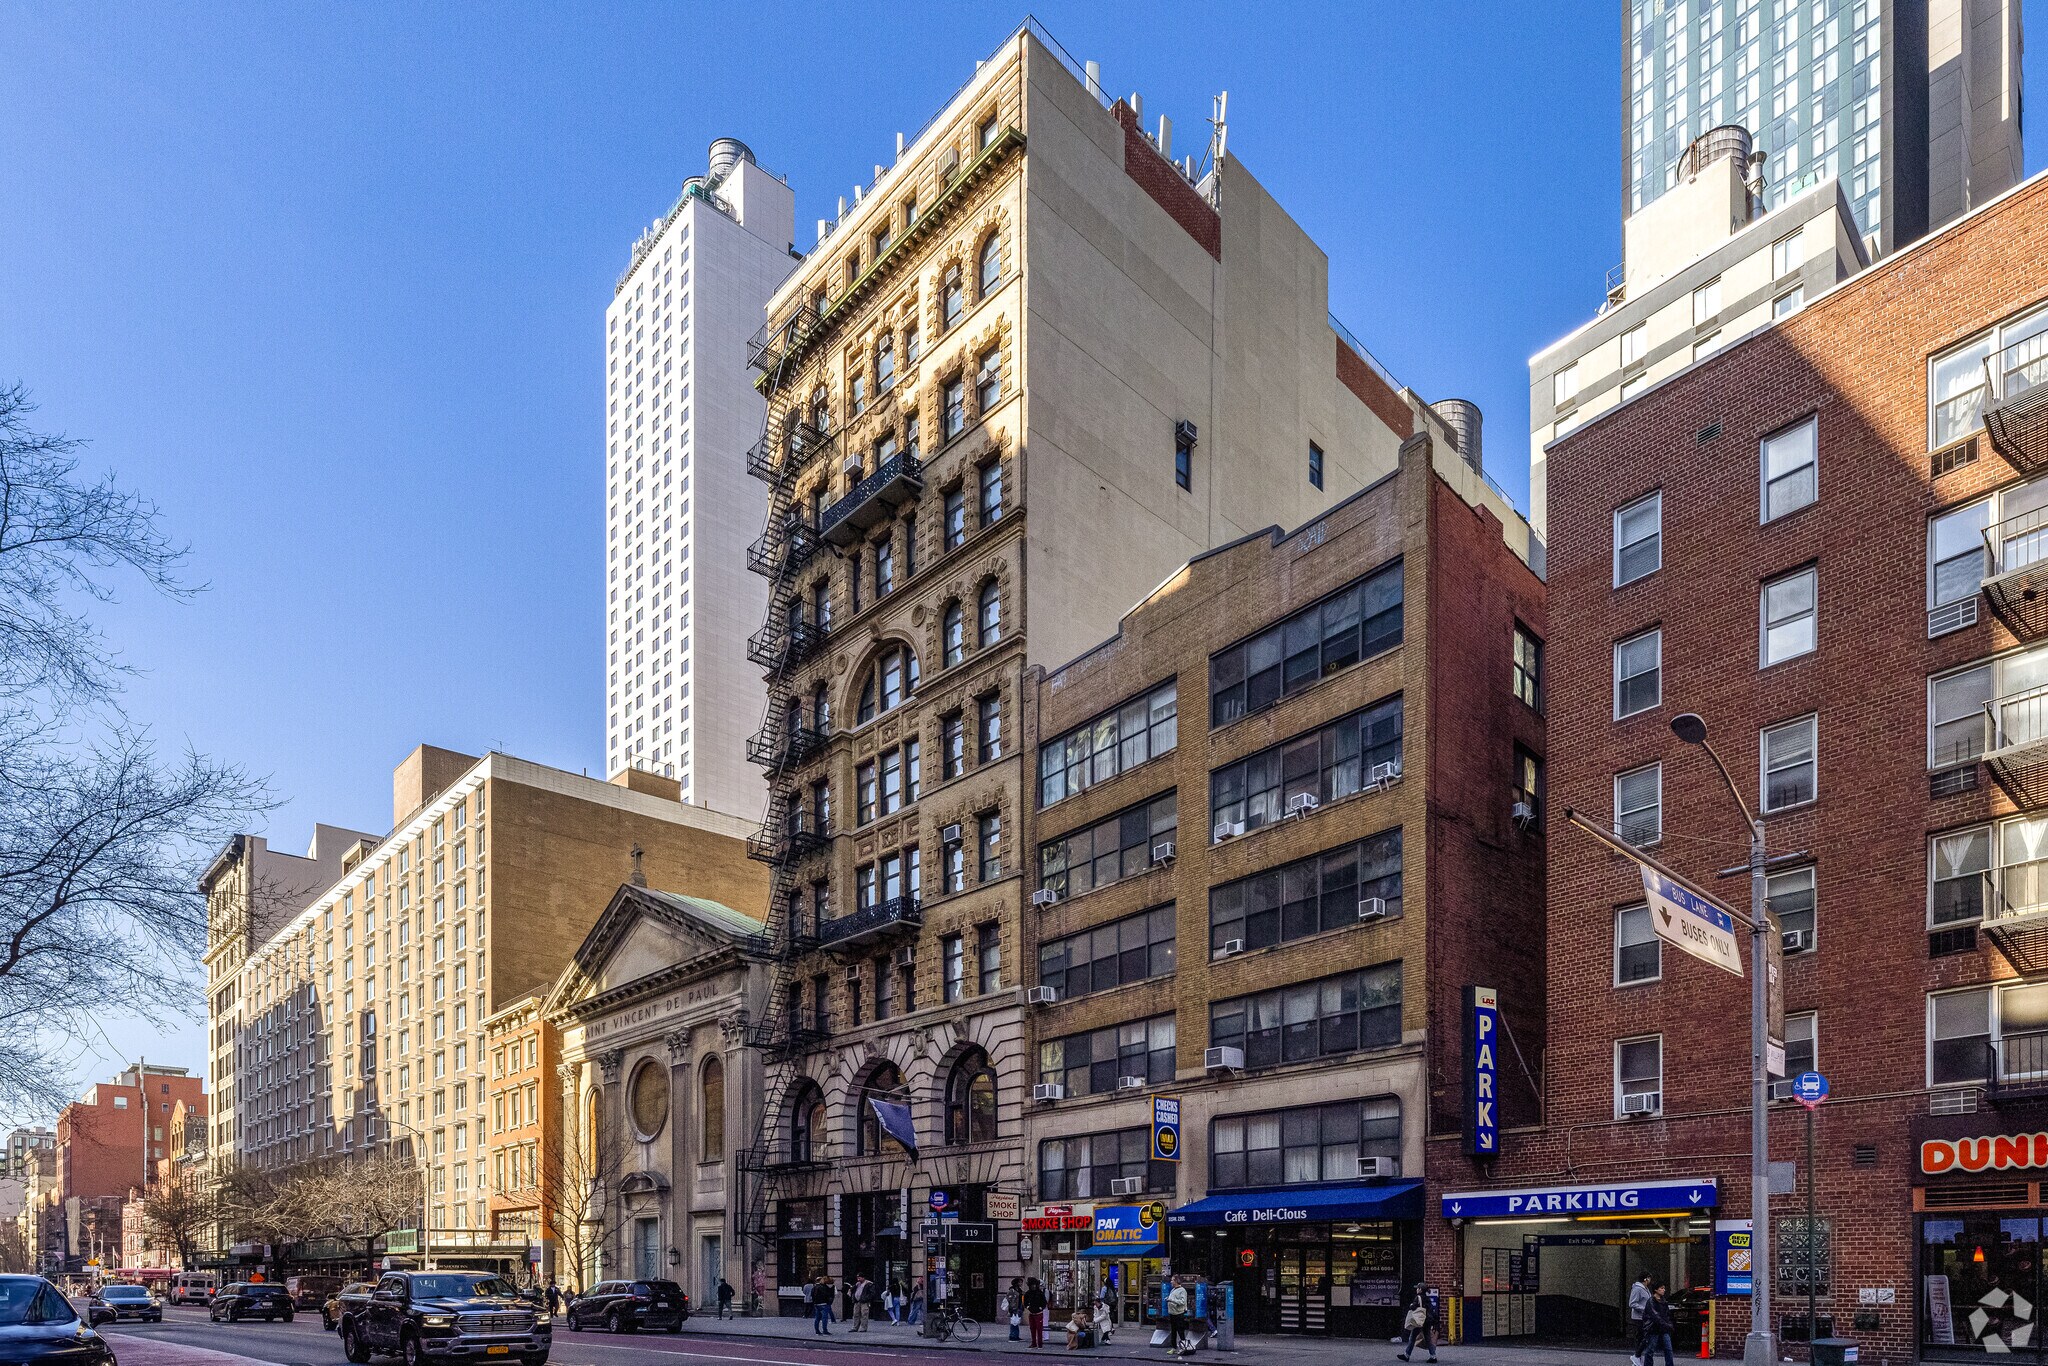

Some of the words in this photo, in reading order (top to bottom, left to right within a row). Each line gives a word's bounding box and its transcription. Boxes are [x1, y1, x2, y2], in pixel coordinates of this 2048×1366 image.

[1672, 887, 1686, 905] BUS
[1691, 898, 1709, 918] LANE
[1681, 919, 1709, 947] BUSES
[1710, 935, 1730, 957] ONLY
[1482, 997, 1495, 1005] LAZ
[580, 1022, 607, 1040] SAINT
[613, 1005, 658, 1029] VINCENT
[666, 997, 680, 1011] DE
[688, 985, 719, 1004] PAUL
[1478, 1014, 1495, 1128] PARK
[1156, 1099, 1178, 1112] CHECKS
[1156, 1111, 1178, 1125] CASHED
[989, 1202, 1017, 1210] SMOKE
[1509, 1190, 1639, 1212] PARKING
[993, 1210, 1014, 1218] SHOP
[1225, 1210, 1248, 1222] Café
[1252, 1208, 1307, 1221] Deli-Cious
[1022, 1217, 1059, 1231] SMOKE
[1061, 1215, 1092, 1229] SHOP
[1097, 1218, 1120, 1230] PAY
[965, 1229, 979, 1237] 119
[1096, 1228, 1143, 1241] OMATIC
[1729, 1249, 1751, 1270] HOME
